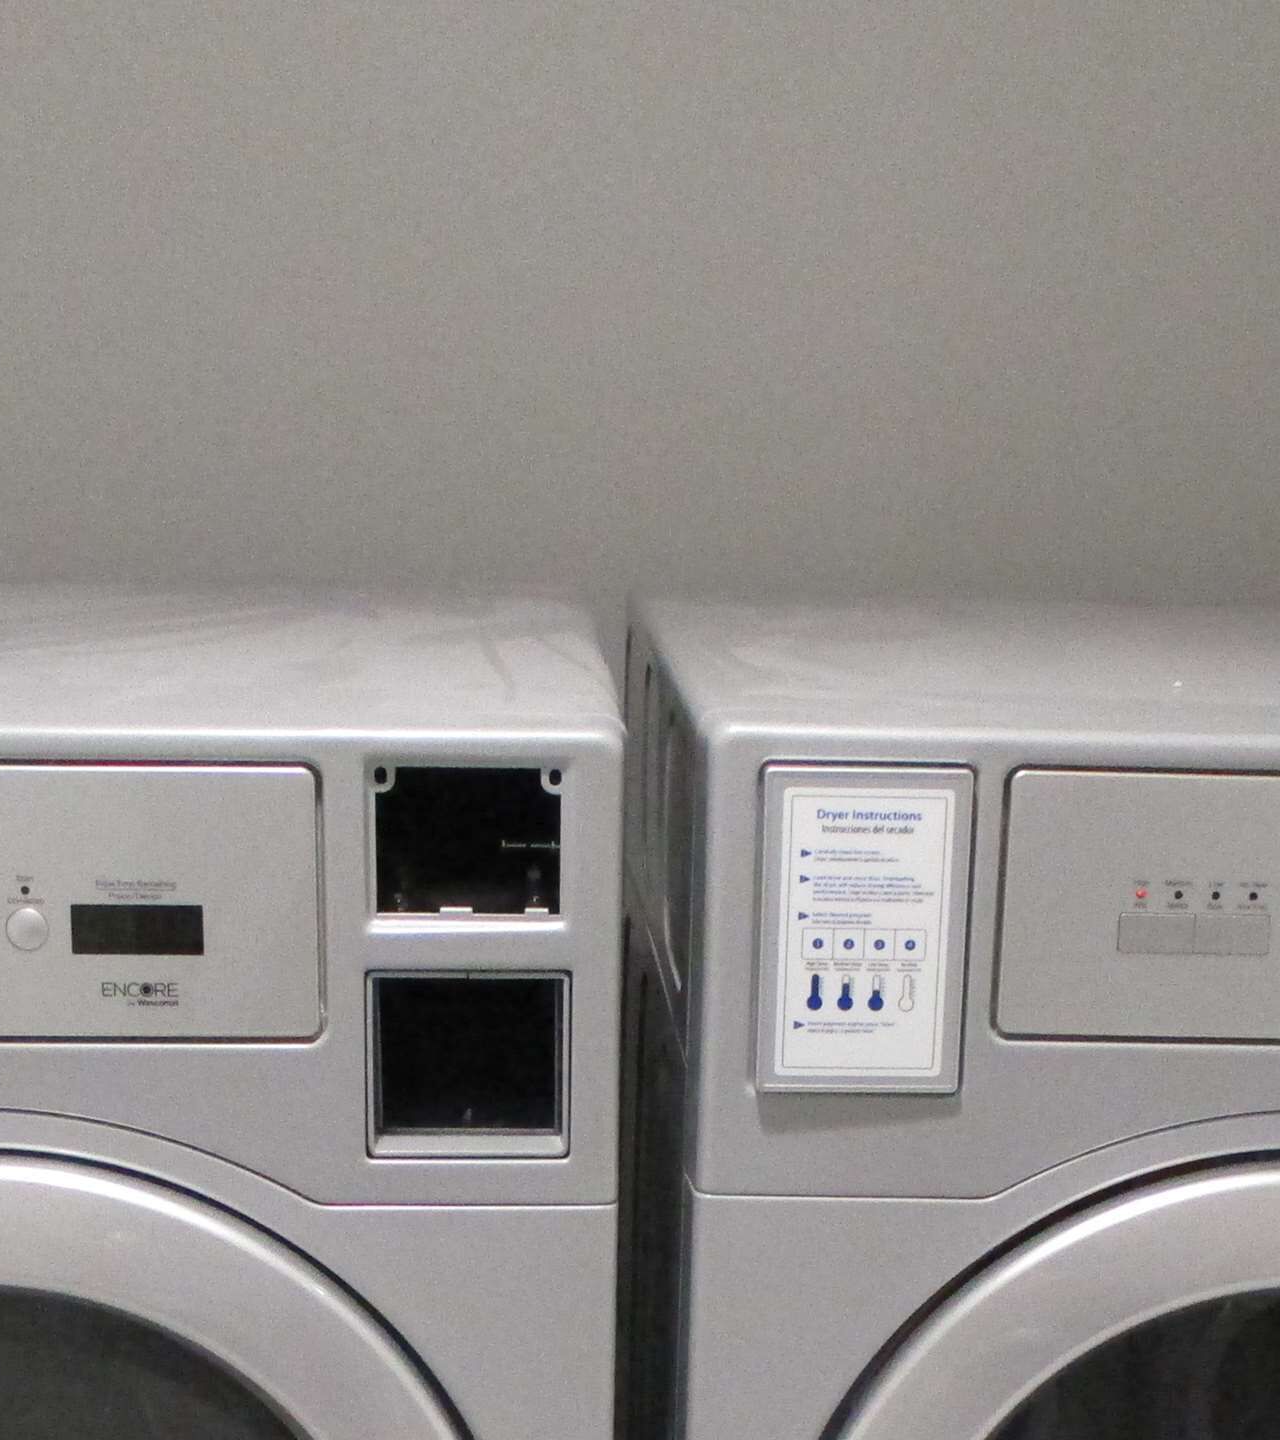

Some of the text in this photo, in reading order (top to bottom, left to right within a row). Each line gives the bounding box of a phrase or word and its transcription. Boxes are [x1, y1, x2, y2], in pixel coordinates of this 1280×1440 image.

[816, 808, 923, 822] Dryer Instructions
[101, 982, 180, 998] ENCORE
